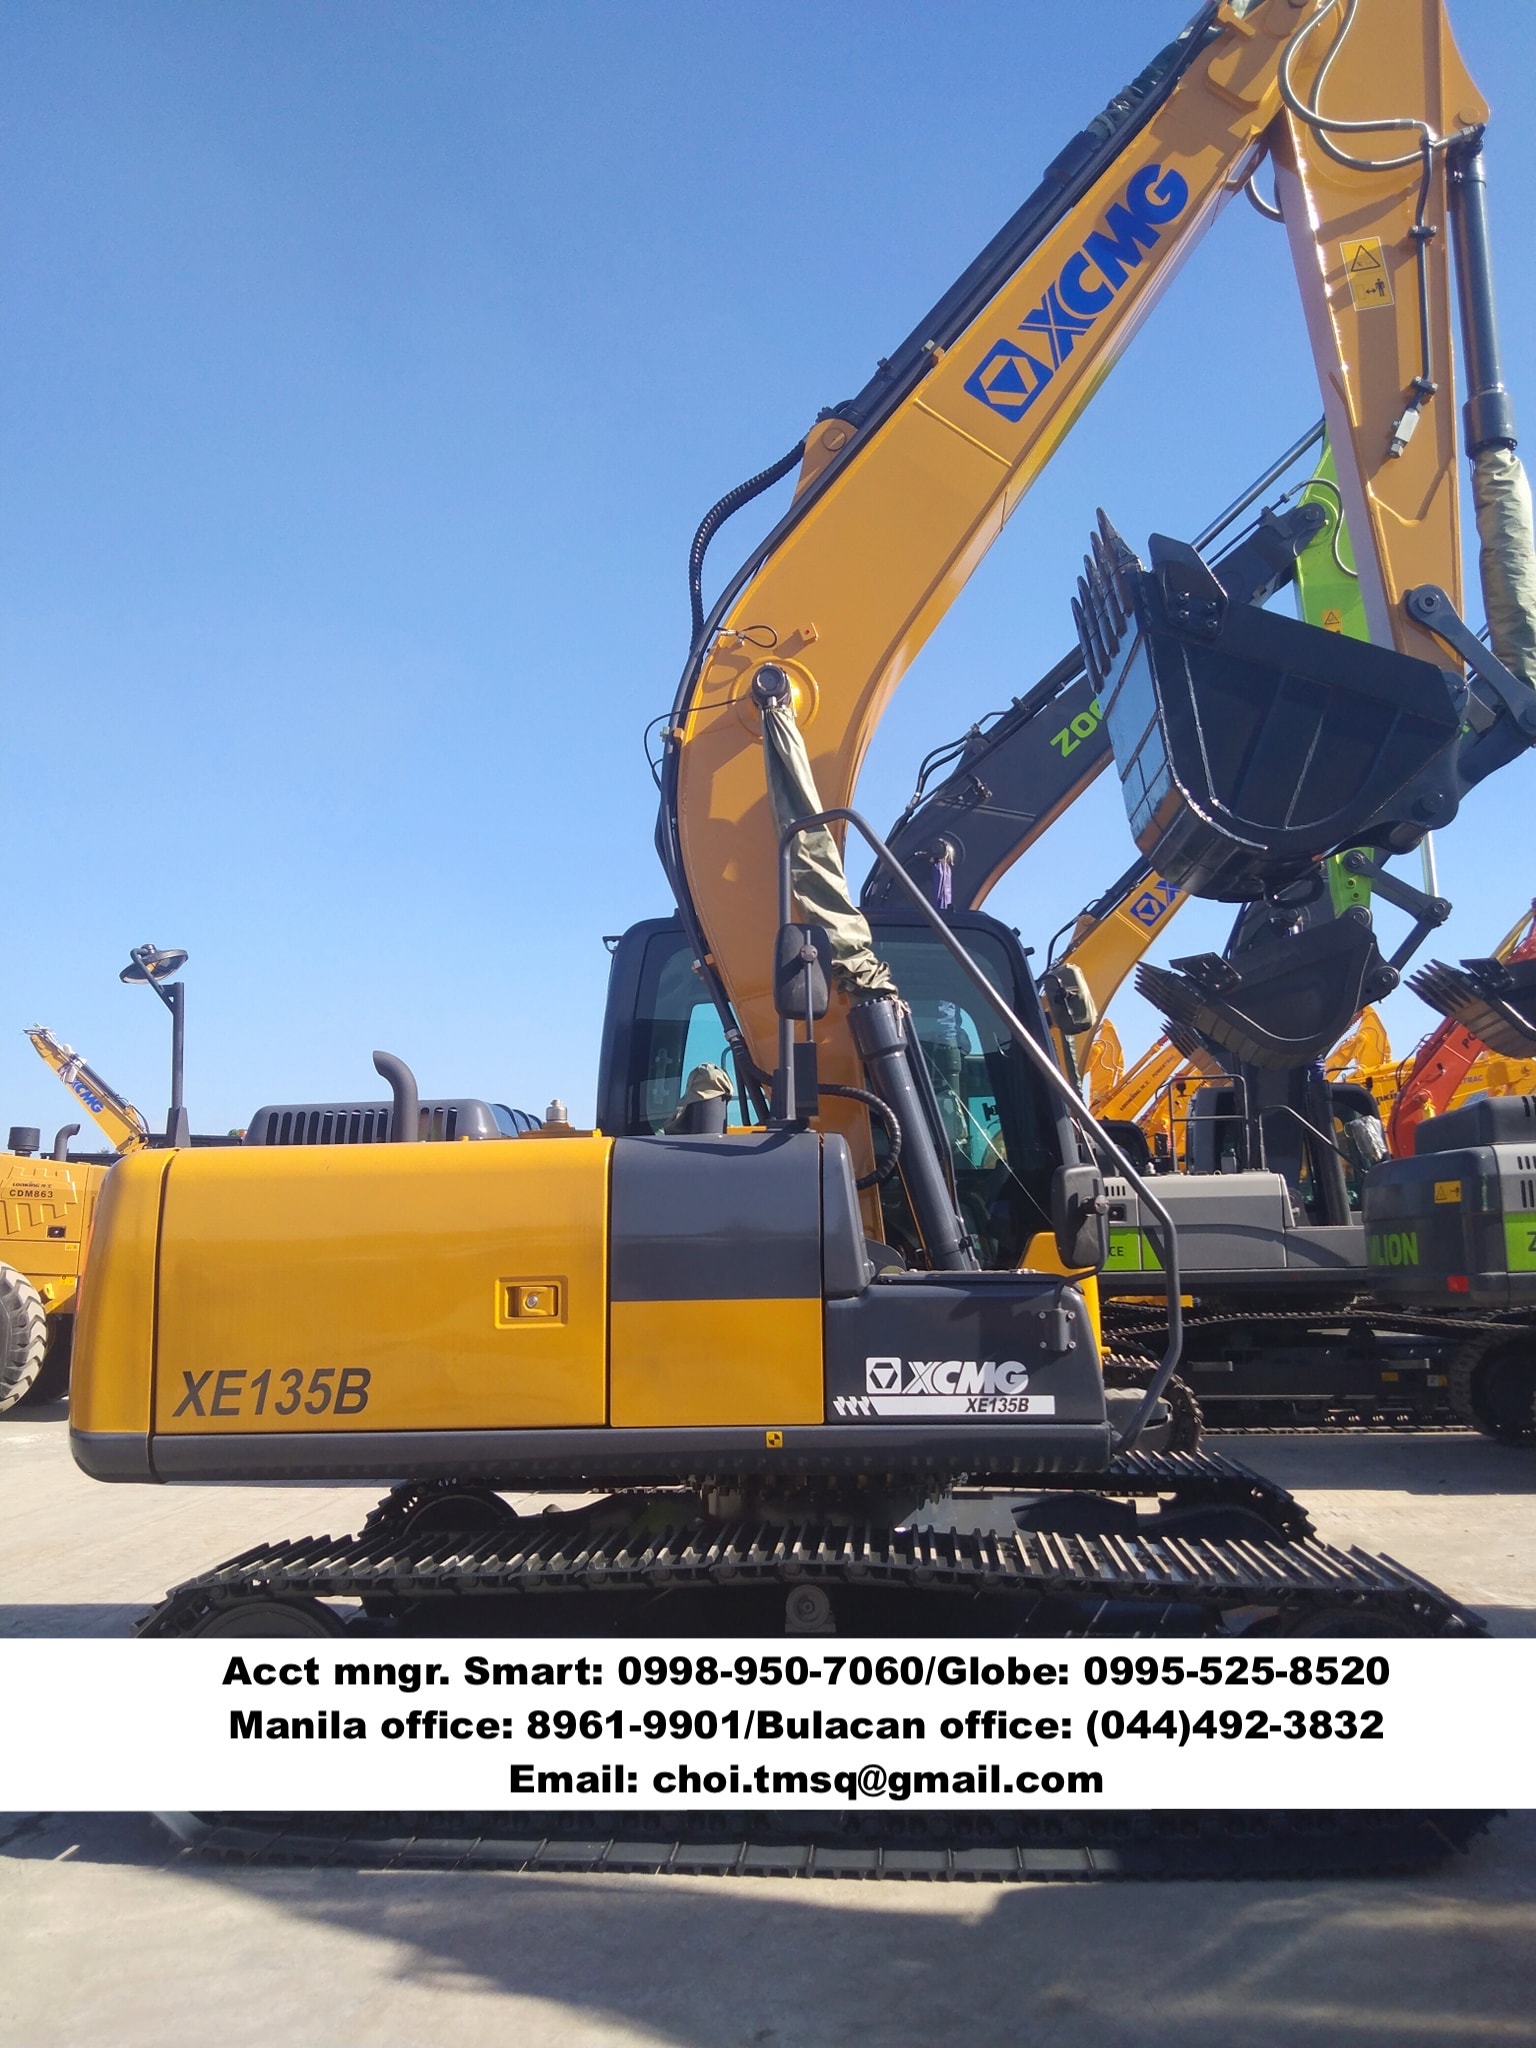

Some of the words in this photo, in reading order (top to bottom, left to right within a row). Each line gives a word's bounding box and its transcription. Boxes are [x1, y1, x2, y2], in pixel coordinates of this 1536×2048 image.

[1017, 164, 1189, 372] XCMG
[10, 1190, 53, 1198] CDM863
[172, 1368, 371, 1417] XE135B
[902, 1361, 1029, 1394] XCMG
[965, 1397, 1029, 1413] XE135B
